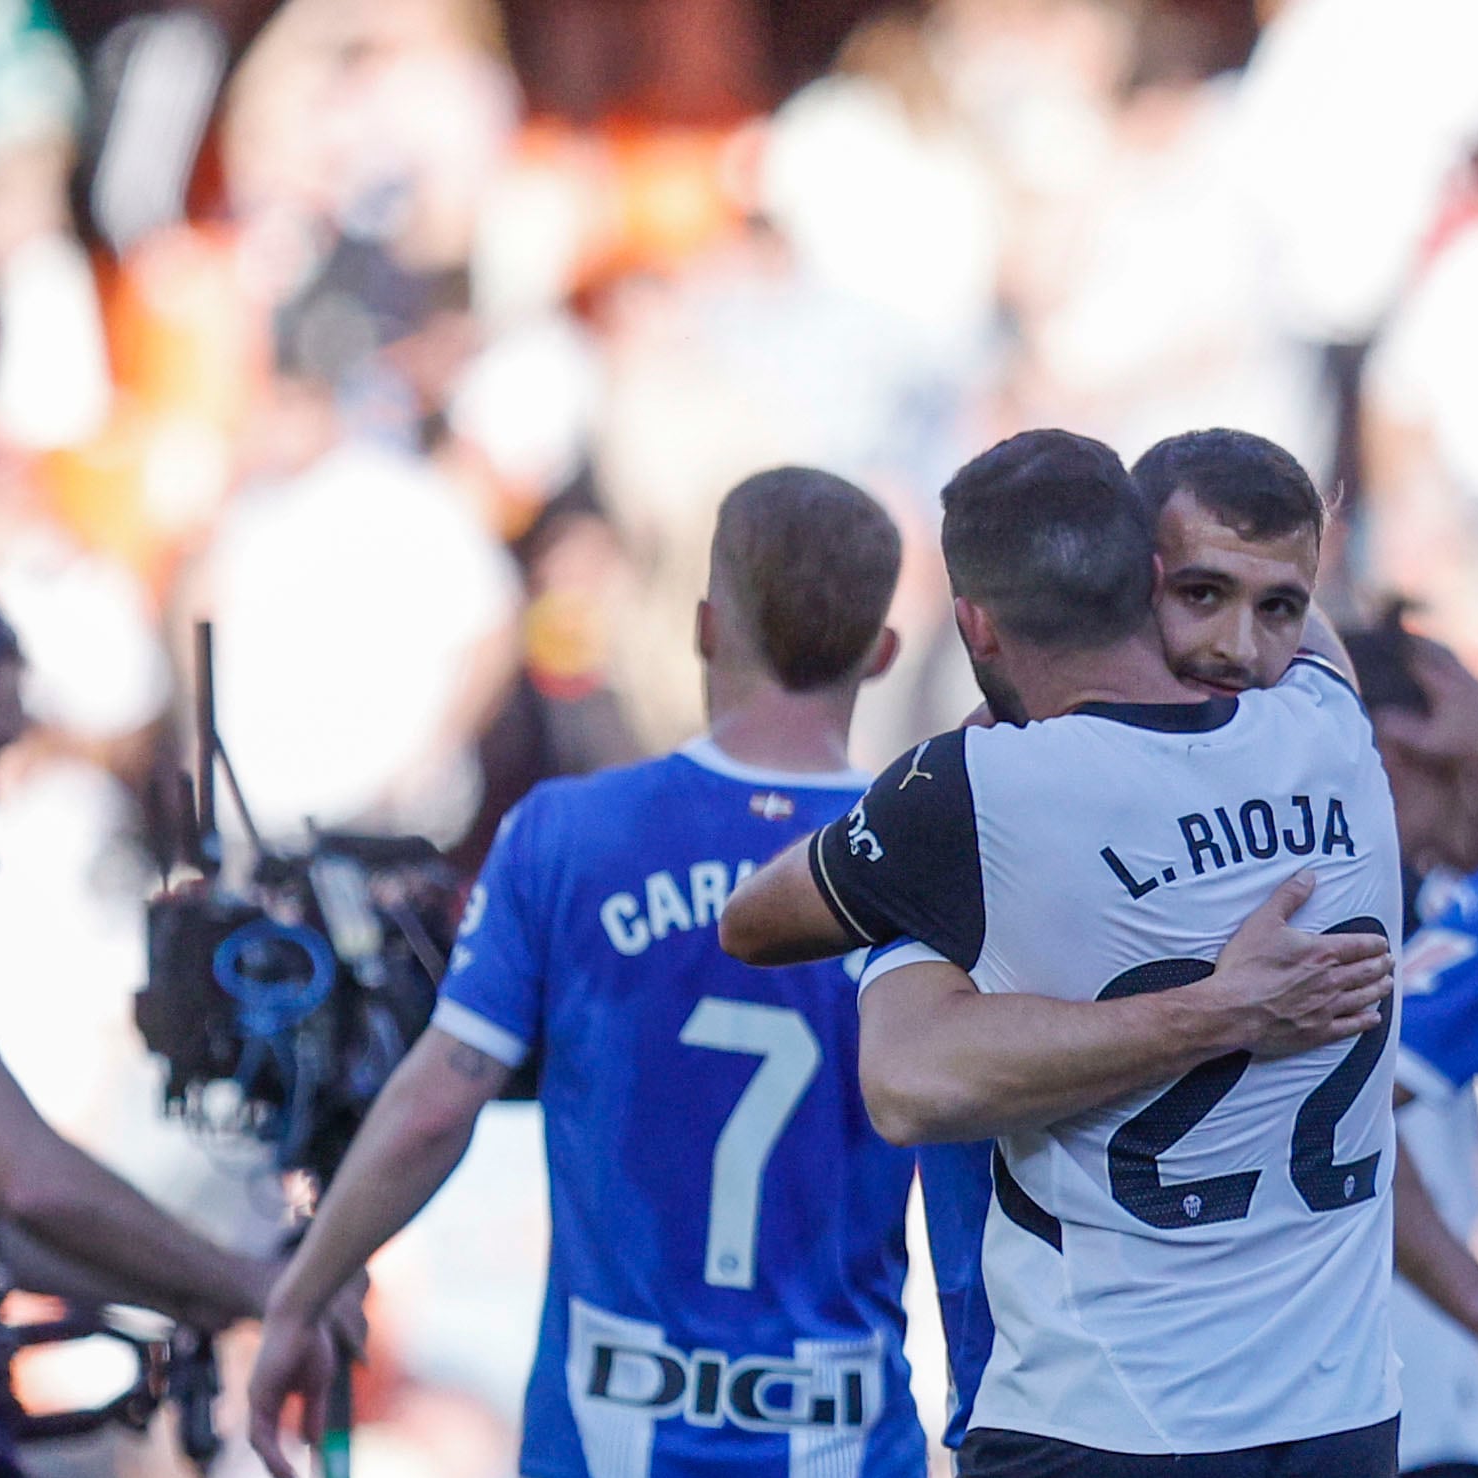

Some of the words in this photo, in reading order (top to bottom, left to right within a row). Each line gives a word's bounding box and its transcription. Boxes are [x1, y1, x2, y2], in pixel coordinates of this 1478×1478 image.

[679, 997, 821, 1289] 7
[1096, 915, 1392, 1230] 22
[586, 1343, 866, 1430] DIGI
